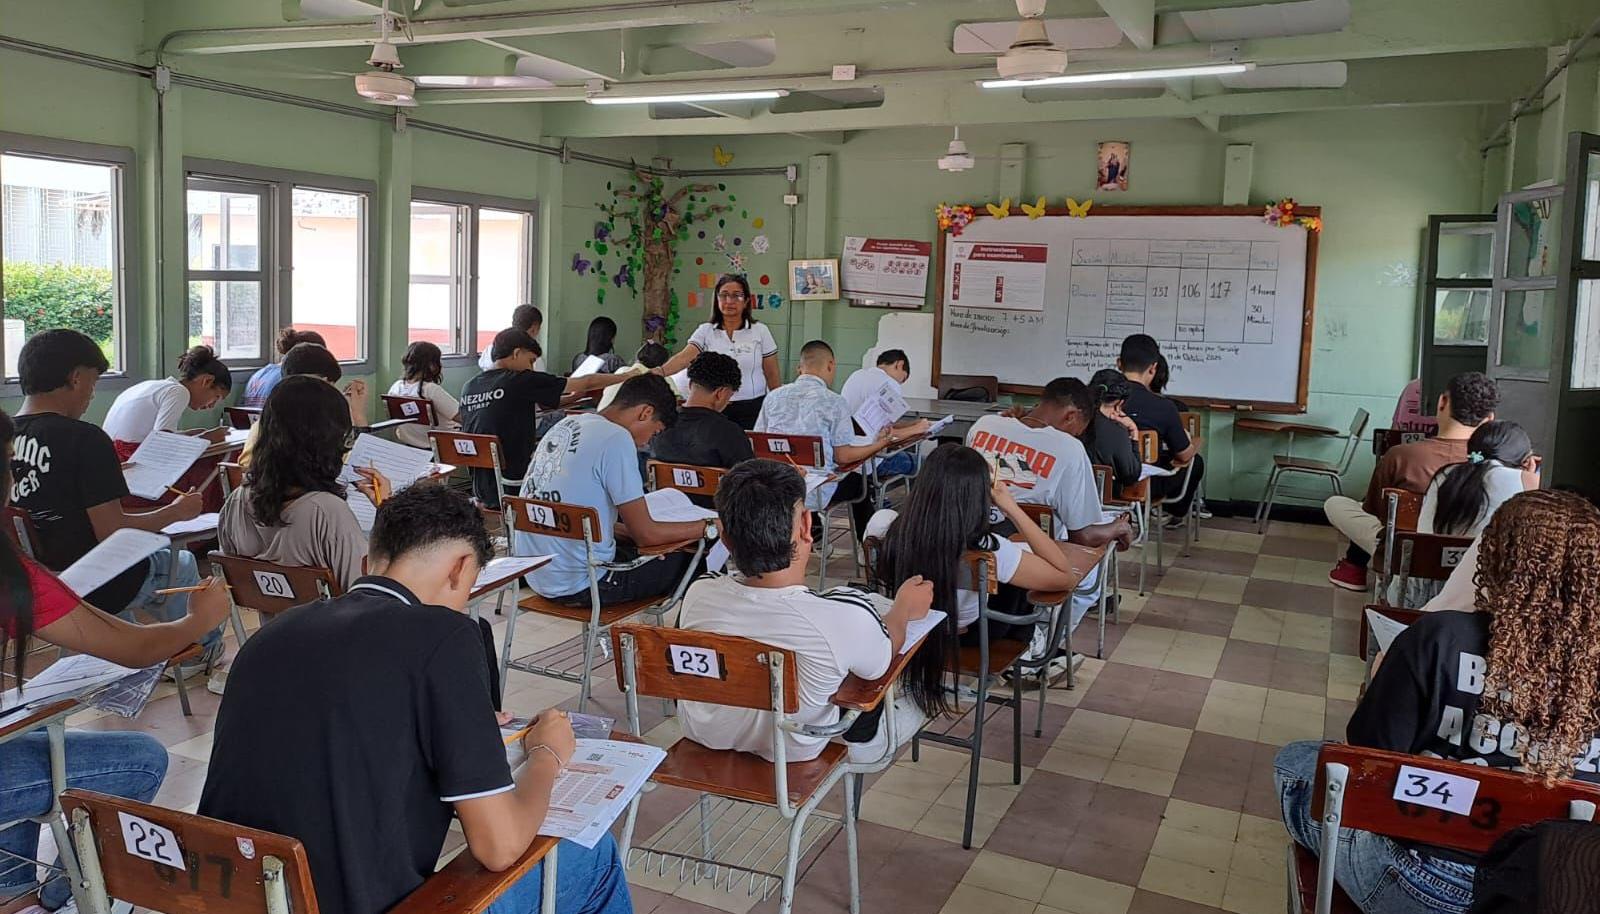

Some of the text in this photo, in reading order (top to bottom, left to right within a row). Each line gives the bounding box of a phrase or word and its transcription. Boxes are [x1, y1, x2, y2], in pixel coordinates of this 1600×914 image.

[1181, 283, 1201, 298] 106
[1209, 281, 1231, 299] 117
[1251, 305, 1262, 313] 30
[460, 388, 505, 407] NEZUKO
[406, 403, 414, 415] 3
[458, 439, 473, 453] 12
[972, 430, 1057, 479] PUMA
[680, 471, 693, 486] 18
[531, 505, 546, 524] 19
[260, 575, 283, 595] 20
[679, 650, 710, 674] 23
[1403, 773, 1454, 805] 34
[129, 821, 173, 862] 22
